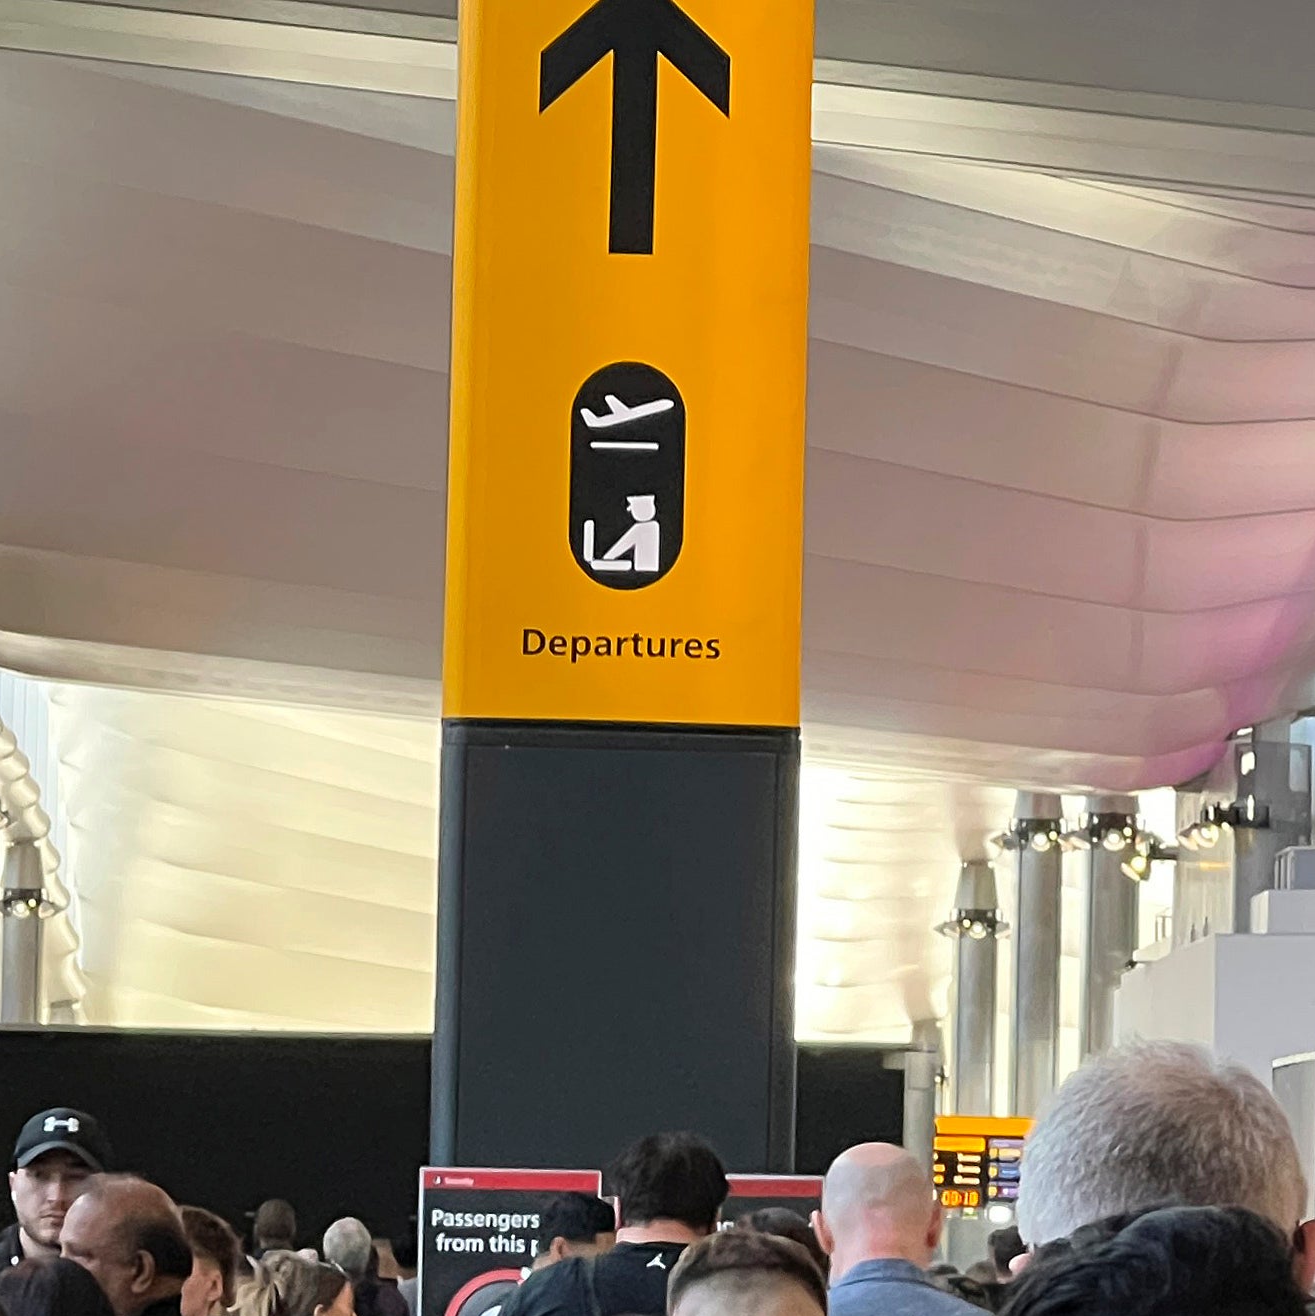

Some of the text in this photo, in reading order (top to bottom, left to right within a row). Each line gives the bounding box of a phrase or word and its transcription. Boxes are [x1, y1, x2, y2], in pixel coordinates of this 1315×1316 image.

[522, 627, 721, 664] Departures
[431, 1208, 540, 1232] Passengers
[436, 1232, 484, 1252] from
[488, 1233, 526, 1254] this
